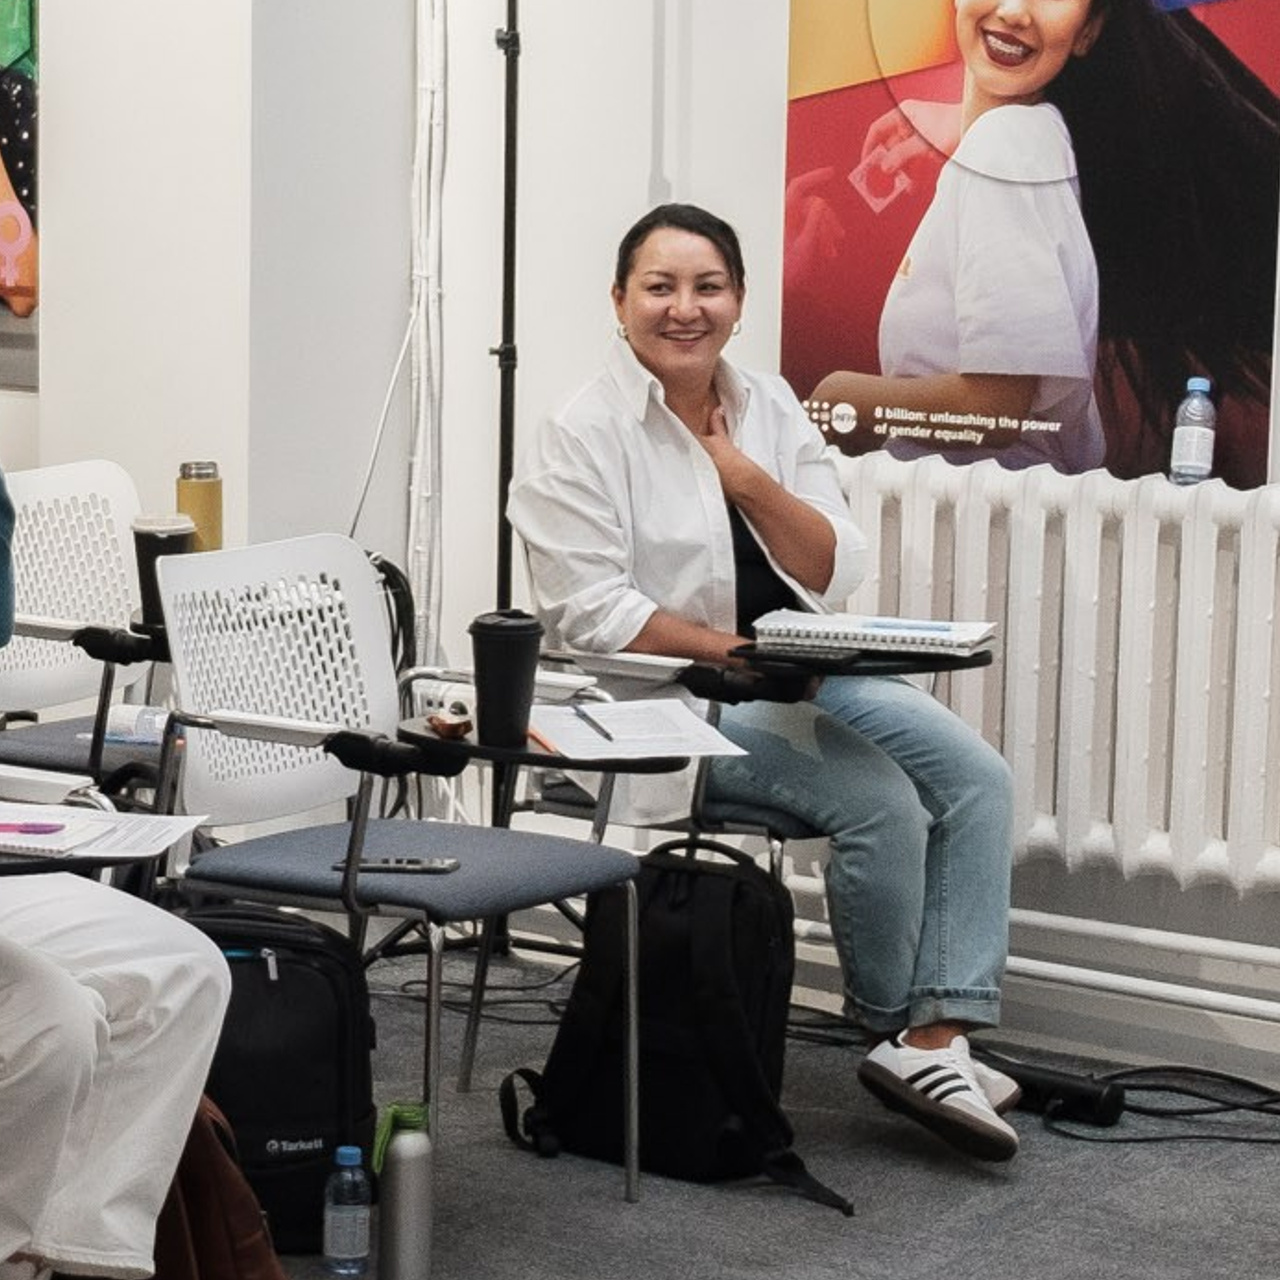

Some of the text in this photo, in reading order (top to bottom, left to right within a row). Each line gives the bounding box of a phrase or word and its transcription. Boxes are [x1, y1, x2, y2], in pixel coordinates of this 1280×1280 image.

[874, 406, 1062, 432] 8 billion: unleashing the power
[873, 423, 984, 445] of gender equality
